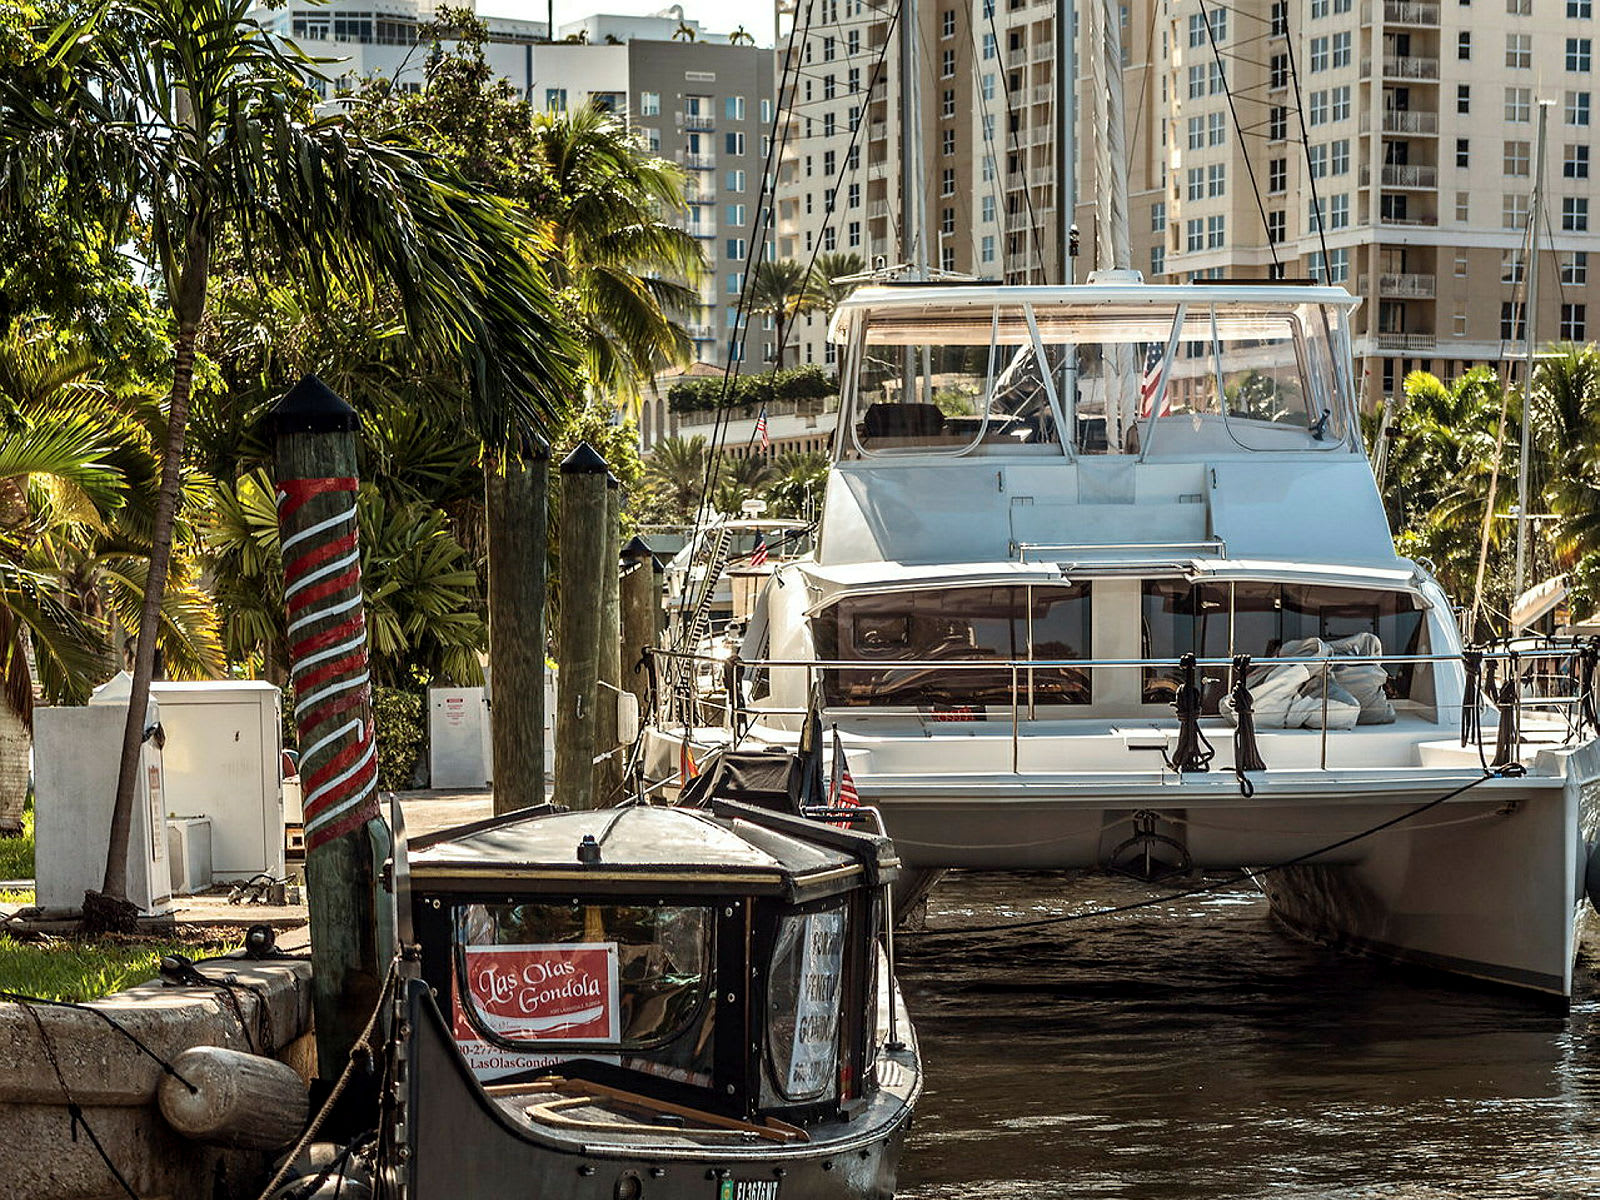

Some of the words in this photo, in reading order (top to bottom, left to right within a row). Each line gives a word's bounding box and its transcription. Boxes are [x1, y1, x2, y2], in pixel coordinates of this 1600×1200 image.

[479, 968, 518, 1004] Las
[522, 958, 576, 984] Olas
[518, 973, 601, 1014] Gondola
